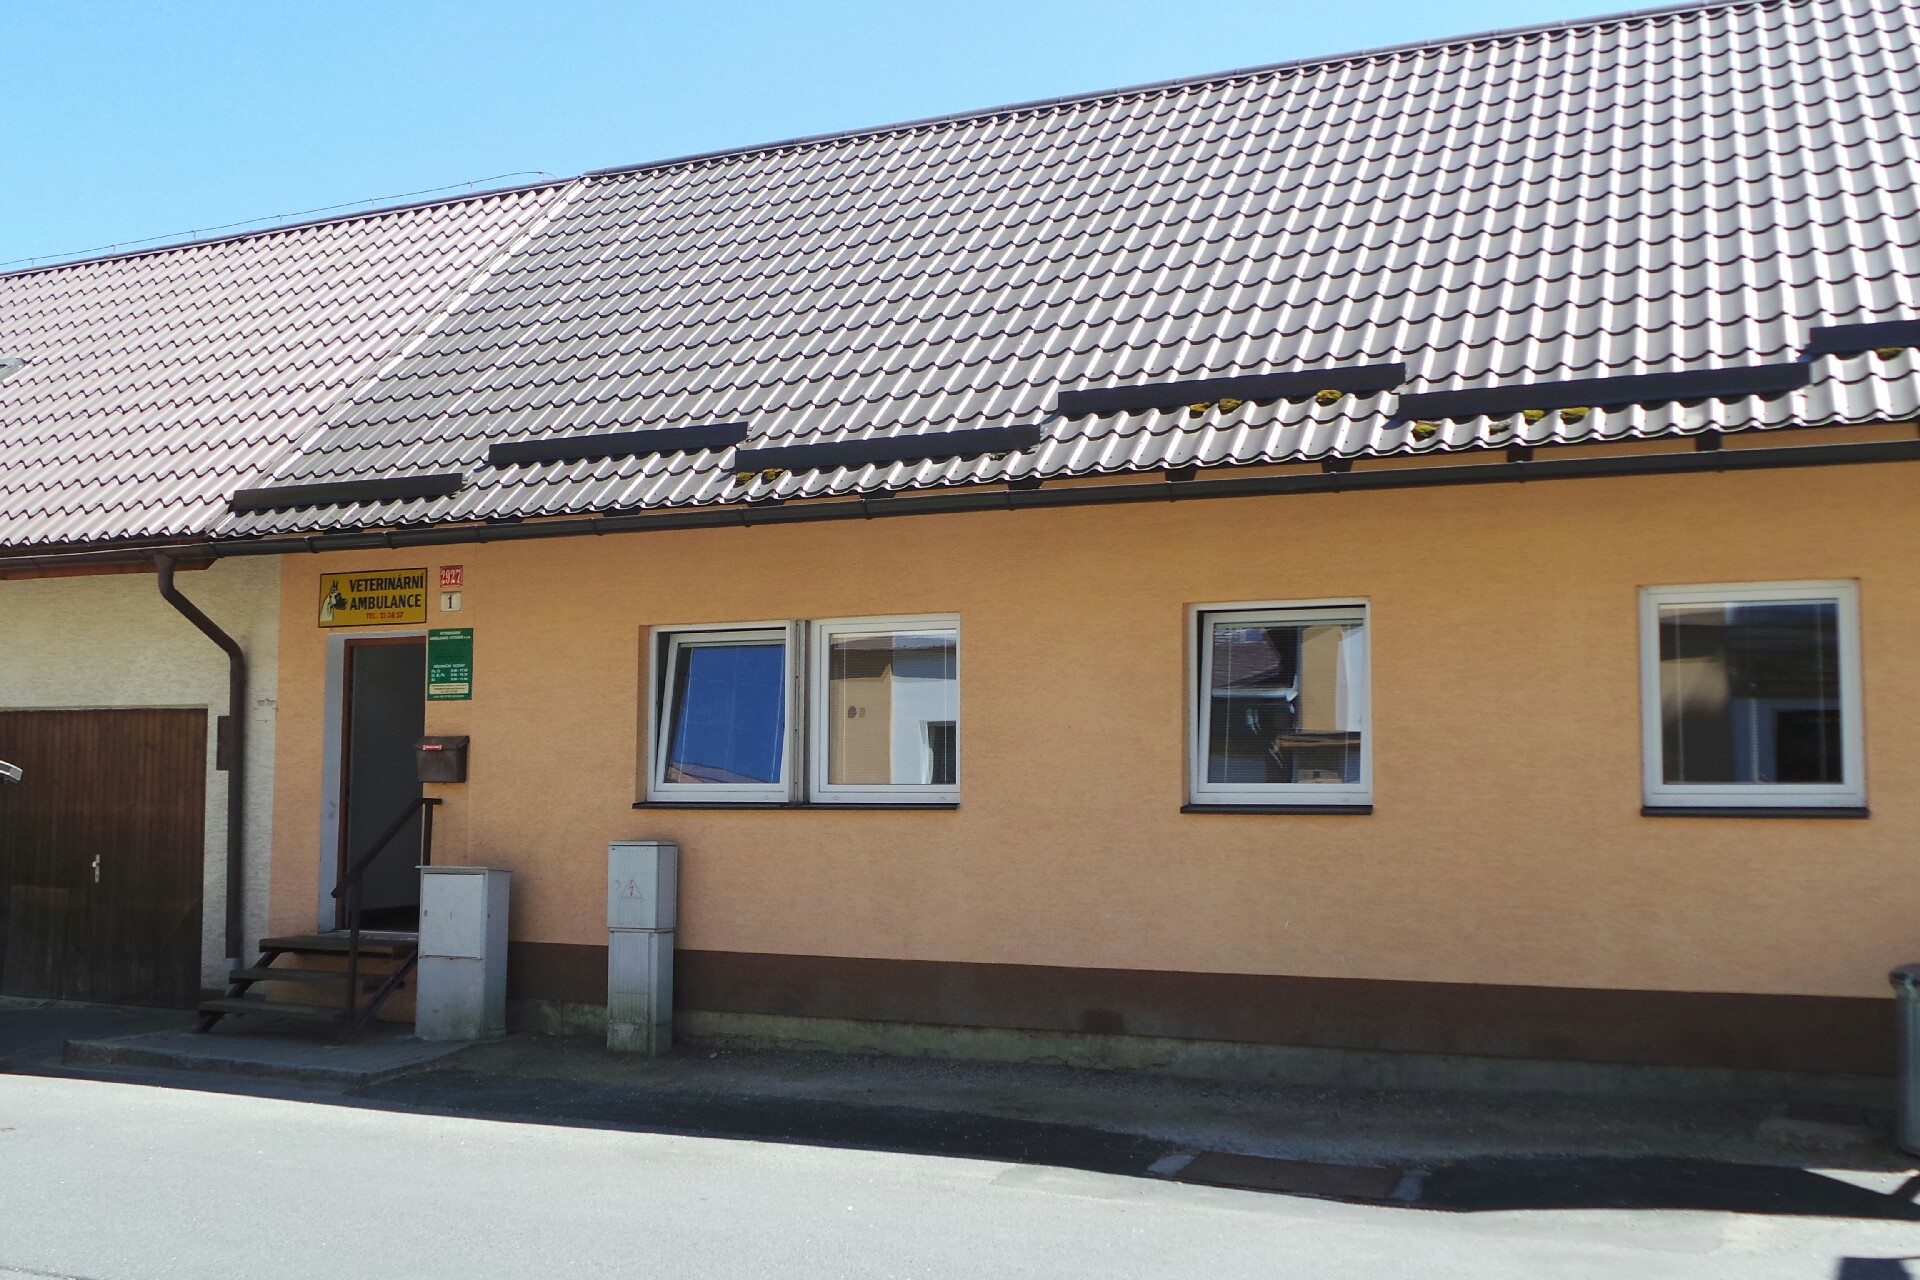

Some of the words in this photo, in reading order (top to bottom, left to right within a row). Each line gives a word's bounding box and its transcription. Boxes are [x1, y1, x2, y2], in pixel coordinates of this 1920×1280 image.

[349, 573, 424, 592] VETERINÁRNÍ
[441, 569, 461, 585] 2927
[349, 594, 422, 610] AMBULANCE
[447, 594, 453, 609] 1
